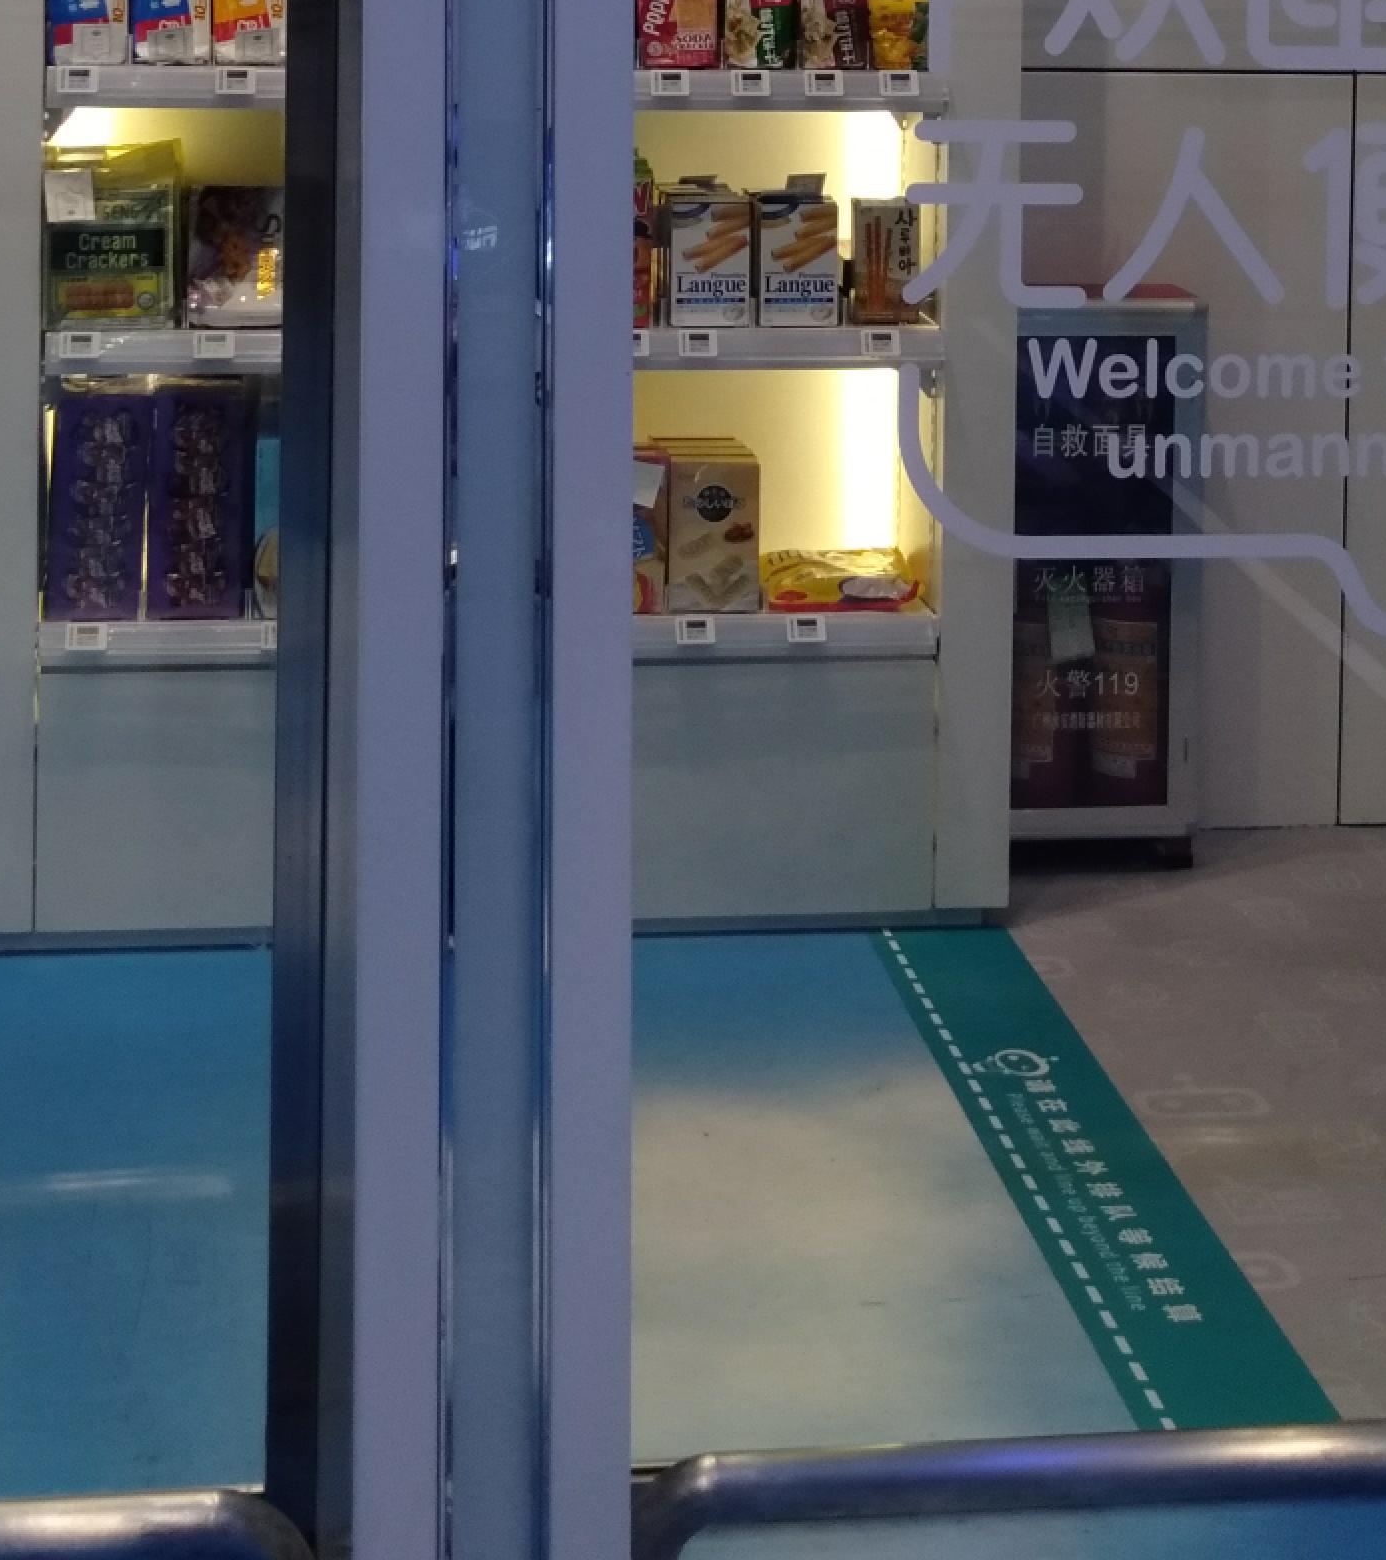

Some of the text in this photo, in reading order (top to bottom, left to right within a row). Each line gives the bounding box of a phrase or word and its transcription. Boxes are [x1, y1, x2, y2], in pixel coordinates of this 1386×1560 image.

[79, 234, 137, 250] Cream
[66, 252, 149, 269] Crackers
[676, 275, 746, 297] Langue
[764, 275, 835, 297] Langue
[1026, 337, 1360, 400] Welcome
[1033, 423, 1151, 457] 自救面具
[1033, 564, 1146, 593] 灭火器箱
